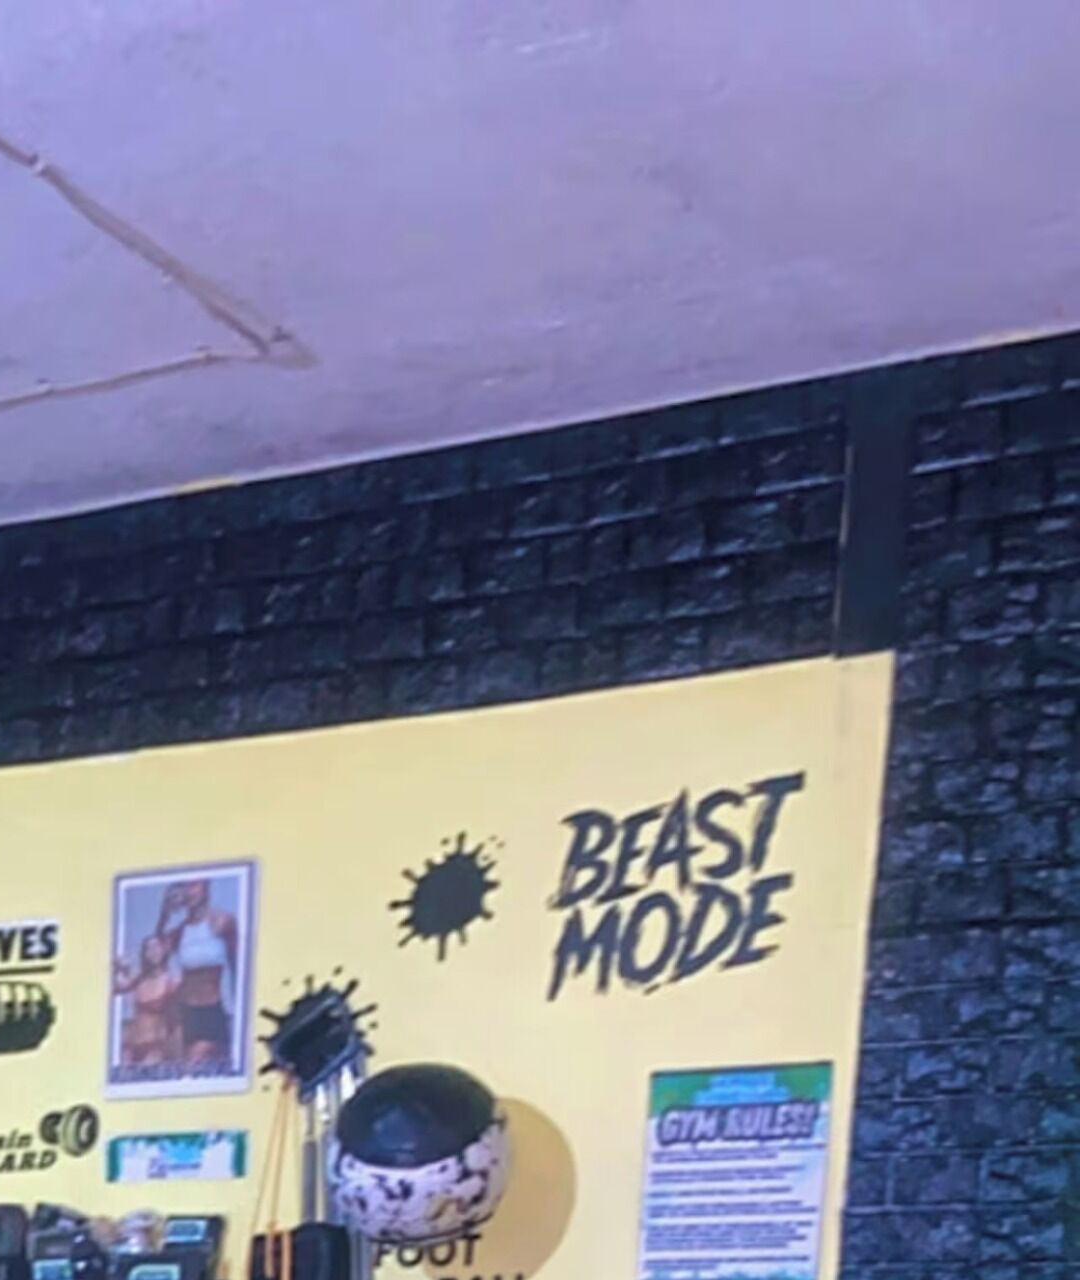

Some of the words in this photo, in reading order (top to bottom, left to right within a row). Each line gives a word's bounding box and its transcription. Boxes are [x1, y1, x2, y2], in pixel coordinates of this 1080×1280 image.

[546, 771, 806, 911] BEAST
[546, 873, 794, 1002] MODE
[662, 1109, 718, 1142] GYM
[371, 1233, 482, 1268] FOOT
